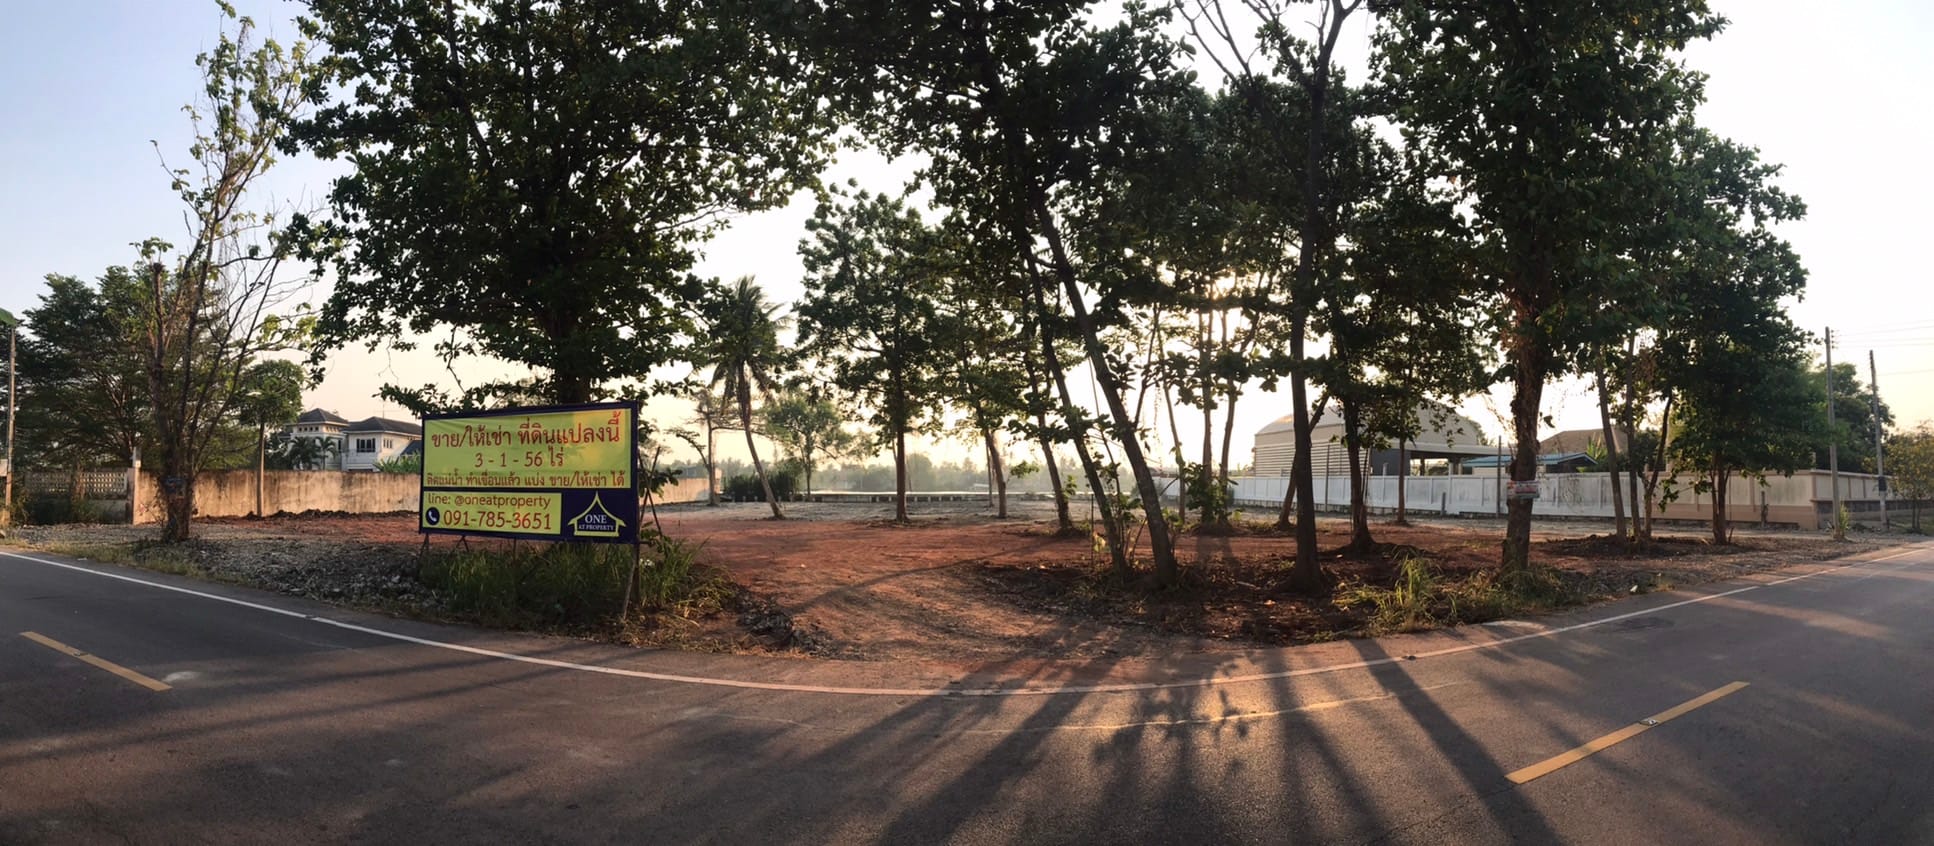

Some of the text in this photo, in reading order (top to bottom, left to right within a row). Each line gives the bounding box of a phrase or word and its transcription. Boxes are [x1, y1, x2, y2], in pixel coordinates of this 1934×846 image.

[431, 411, 621, 448] ขาย/ให้เช่า ที่ดินแปลงนี้
[474, 452, 483, 468] 3
[500, 452, 507, 468] 1
[524, 451, 543, 467] 56
[548, 445, 564, 467] ไร่
[466, 470, 520, 486] ทำเขื่อนแล้ว
[525, 473, 545, 486] แบ่ง
[550, 471, 607, 487] ขาย/ให้เช่า
[611, 471, 625, 486] ได้
[428, 493, 551, 509] line: @oneatproperty
[443, 510, 552, 530] 091-785-3651
[584, 514, 607, 524] ONE
